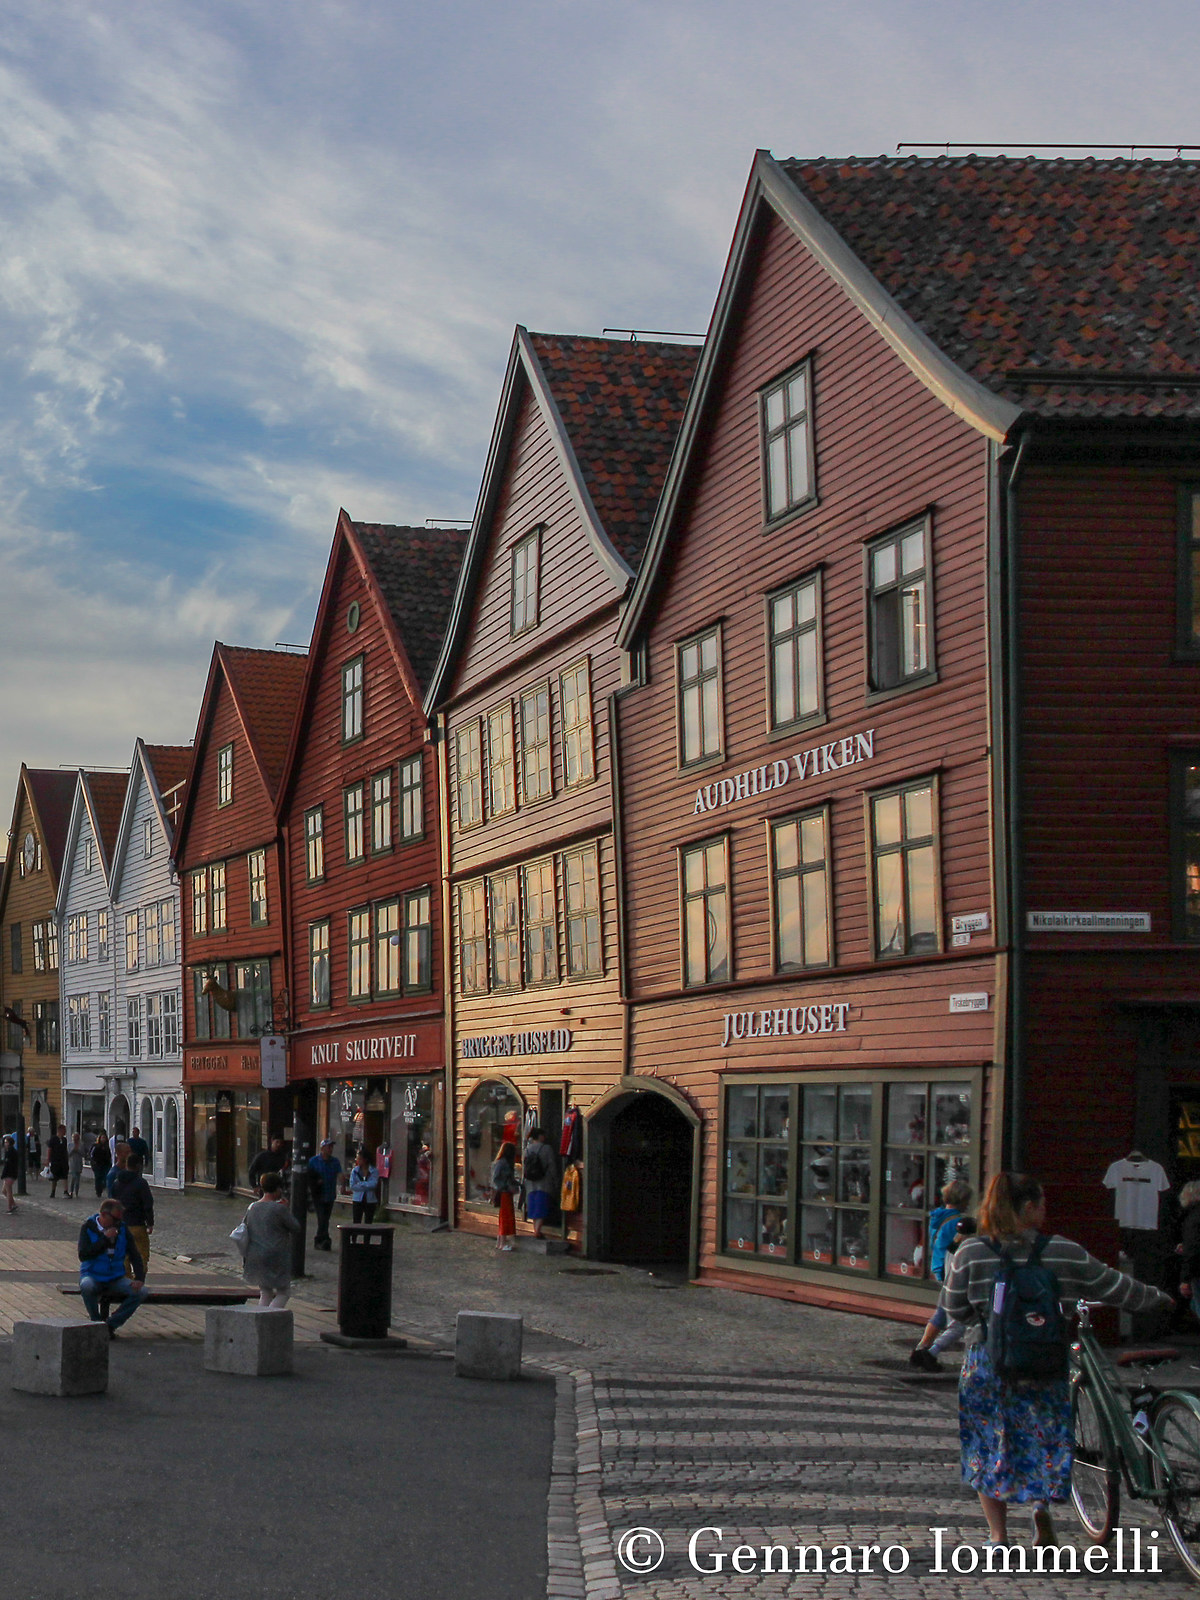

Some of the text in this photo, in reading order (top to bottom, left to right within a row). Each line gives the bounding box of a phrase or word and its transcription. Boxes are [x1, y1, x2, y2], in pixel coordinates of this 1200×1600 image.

[692, 729, 875, 815] AUDHILD VIKEN
[1032, 914, 1146, 929] Nikolaikirkeallmenningen
[721, 1002, 850, 1048] JULEHUSET
[311, 1034, 417, 1065] KNUT SKURTVEIT
[461, 1028, 572, 1058] BRYGGEN HUSFLID
